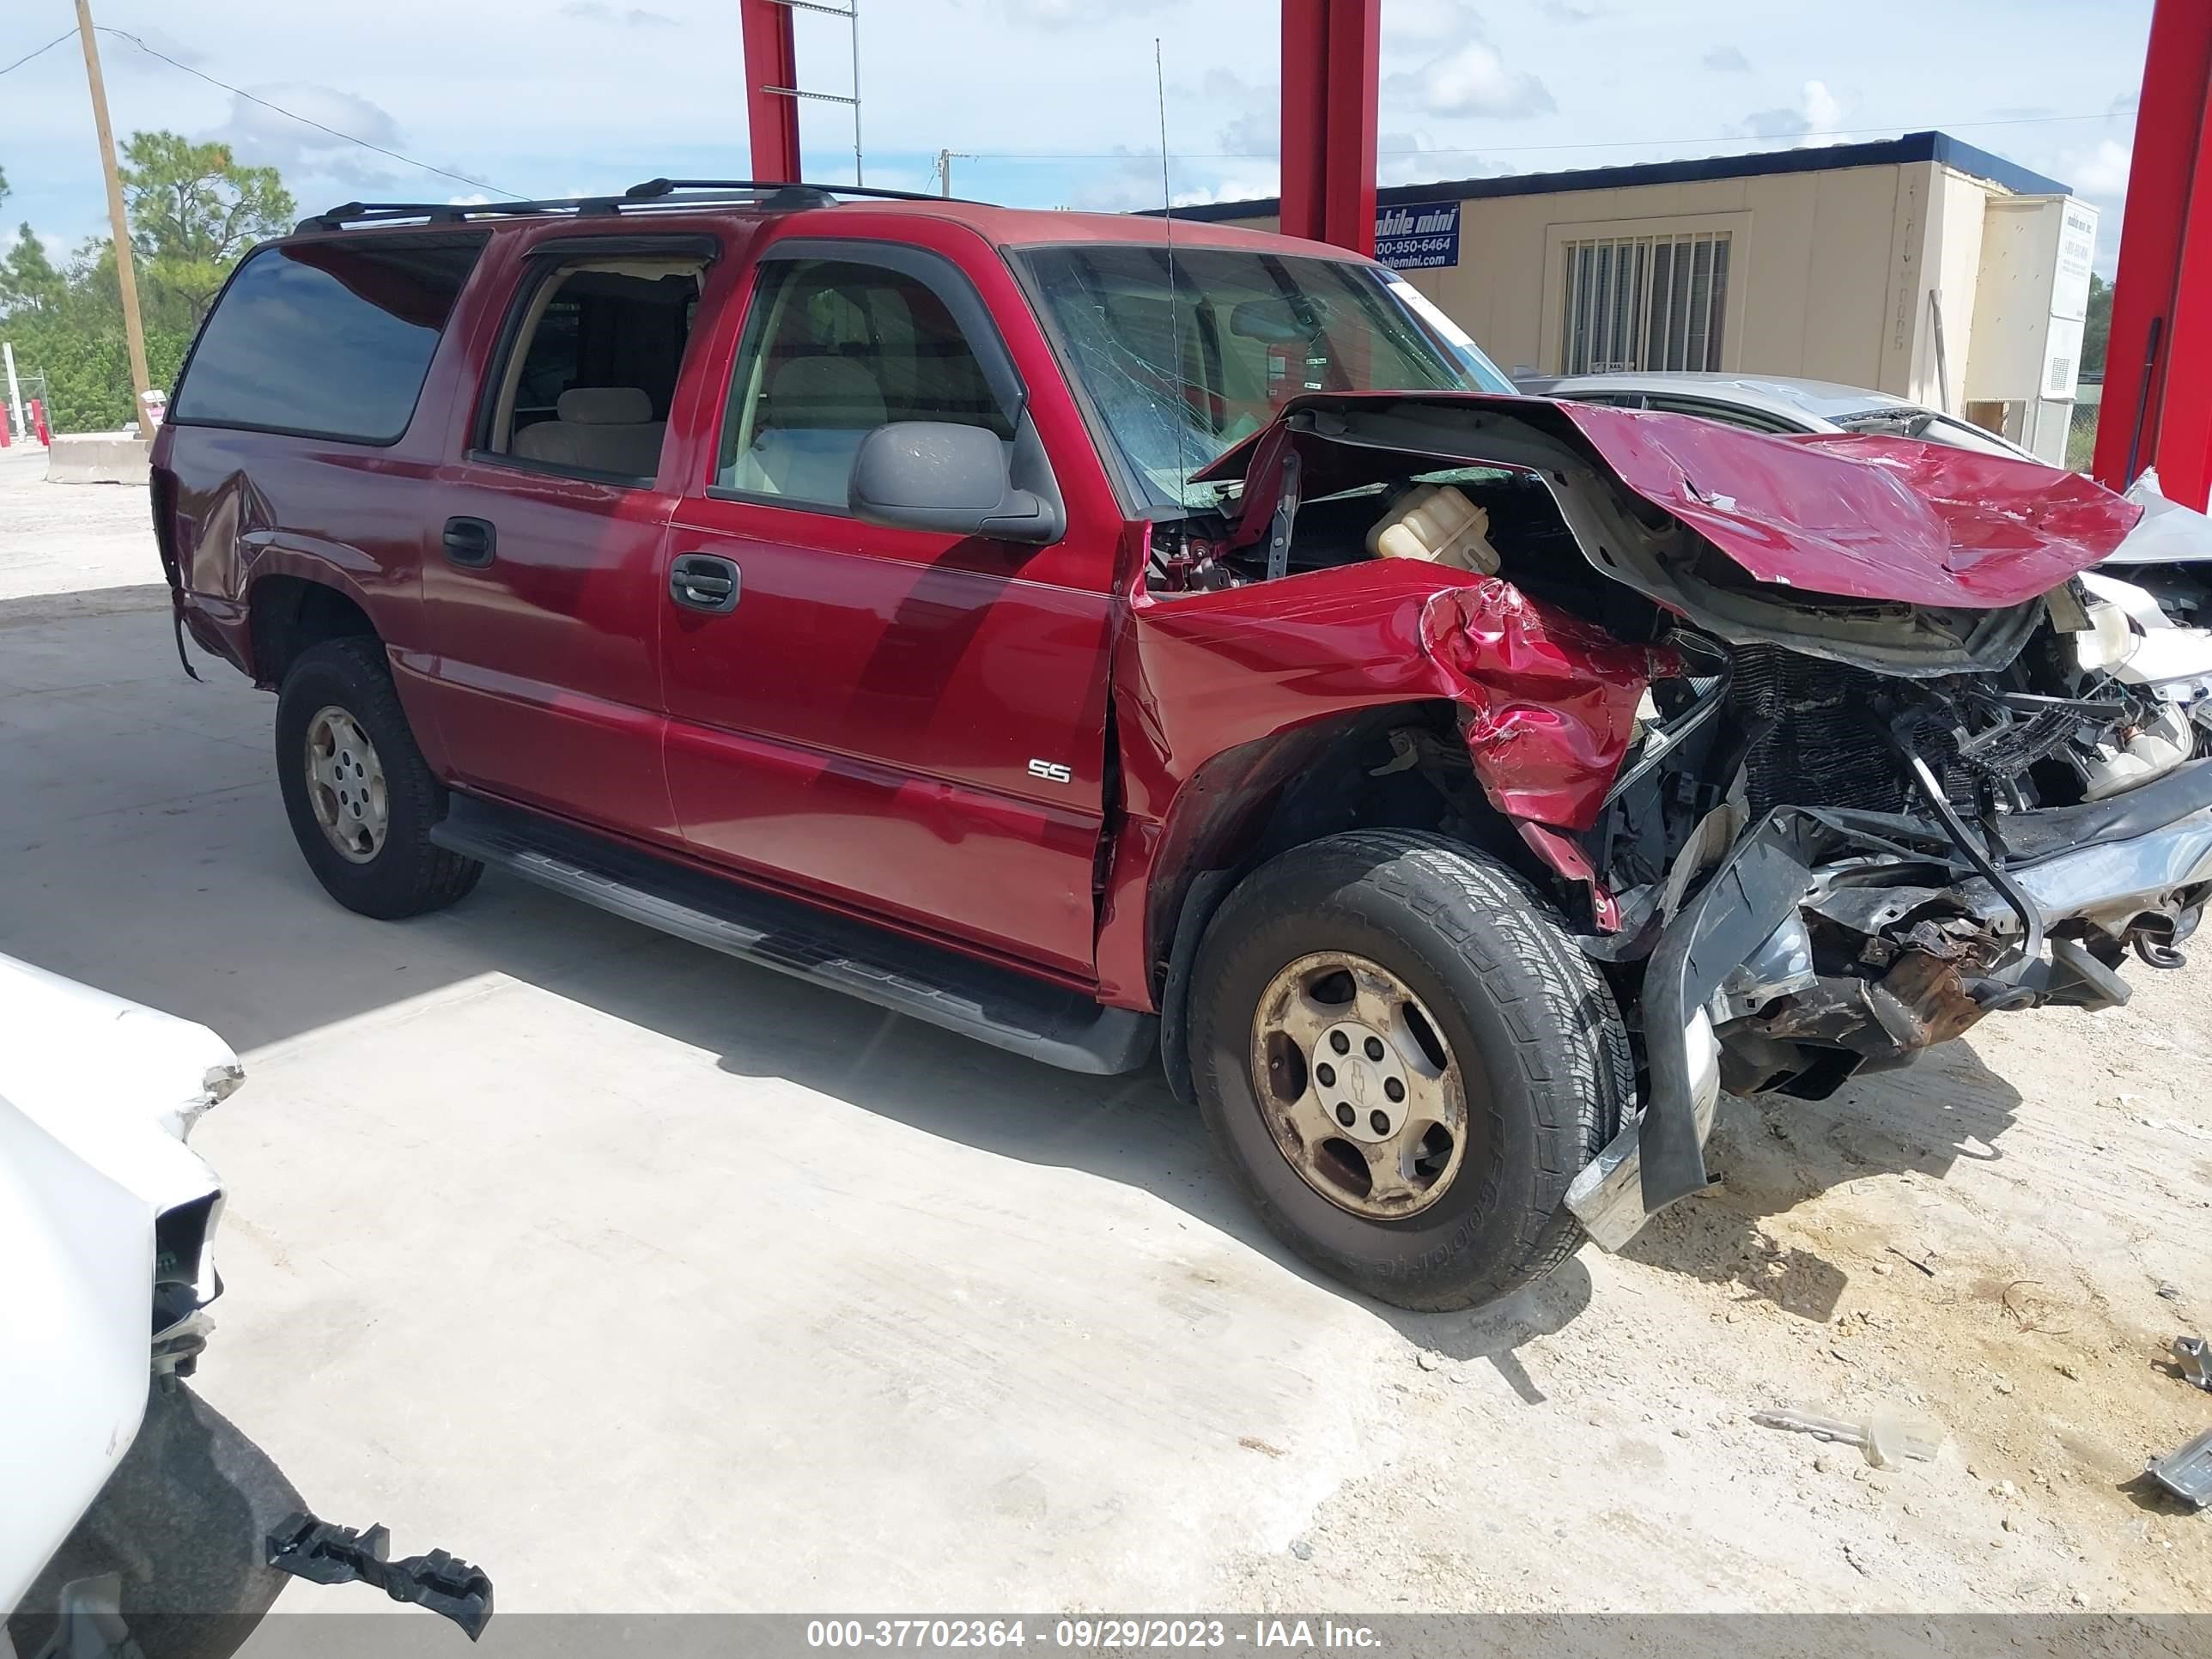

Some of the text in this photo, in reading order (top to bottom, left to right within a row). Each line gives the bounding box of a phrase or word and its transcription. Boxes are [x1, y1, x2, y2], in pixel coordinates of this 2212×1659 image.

[1374, 208, 1456, 236] obile mini
[1374, 237, 1451, 255] 00-950-6464
[1028, 758, 1072, 784] SS
